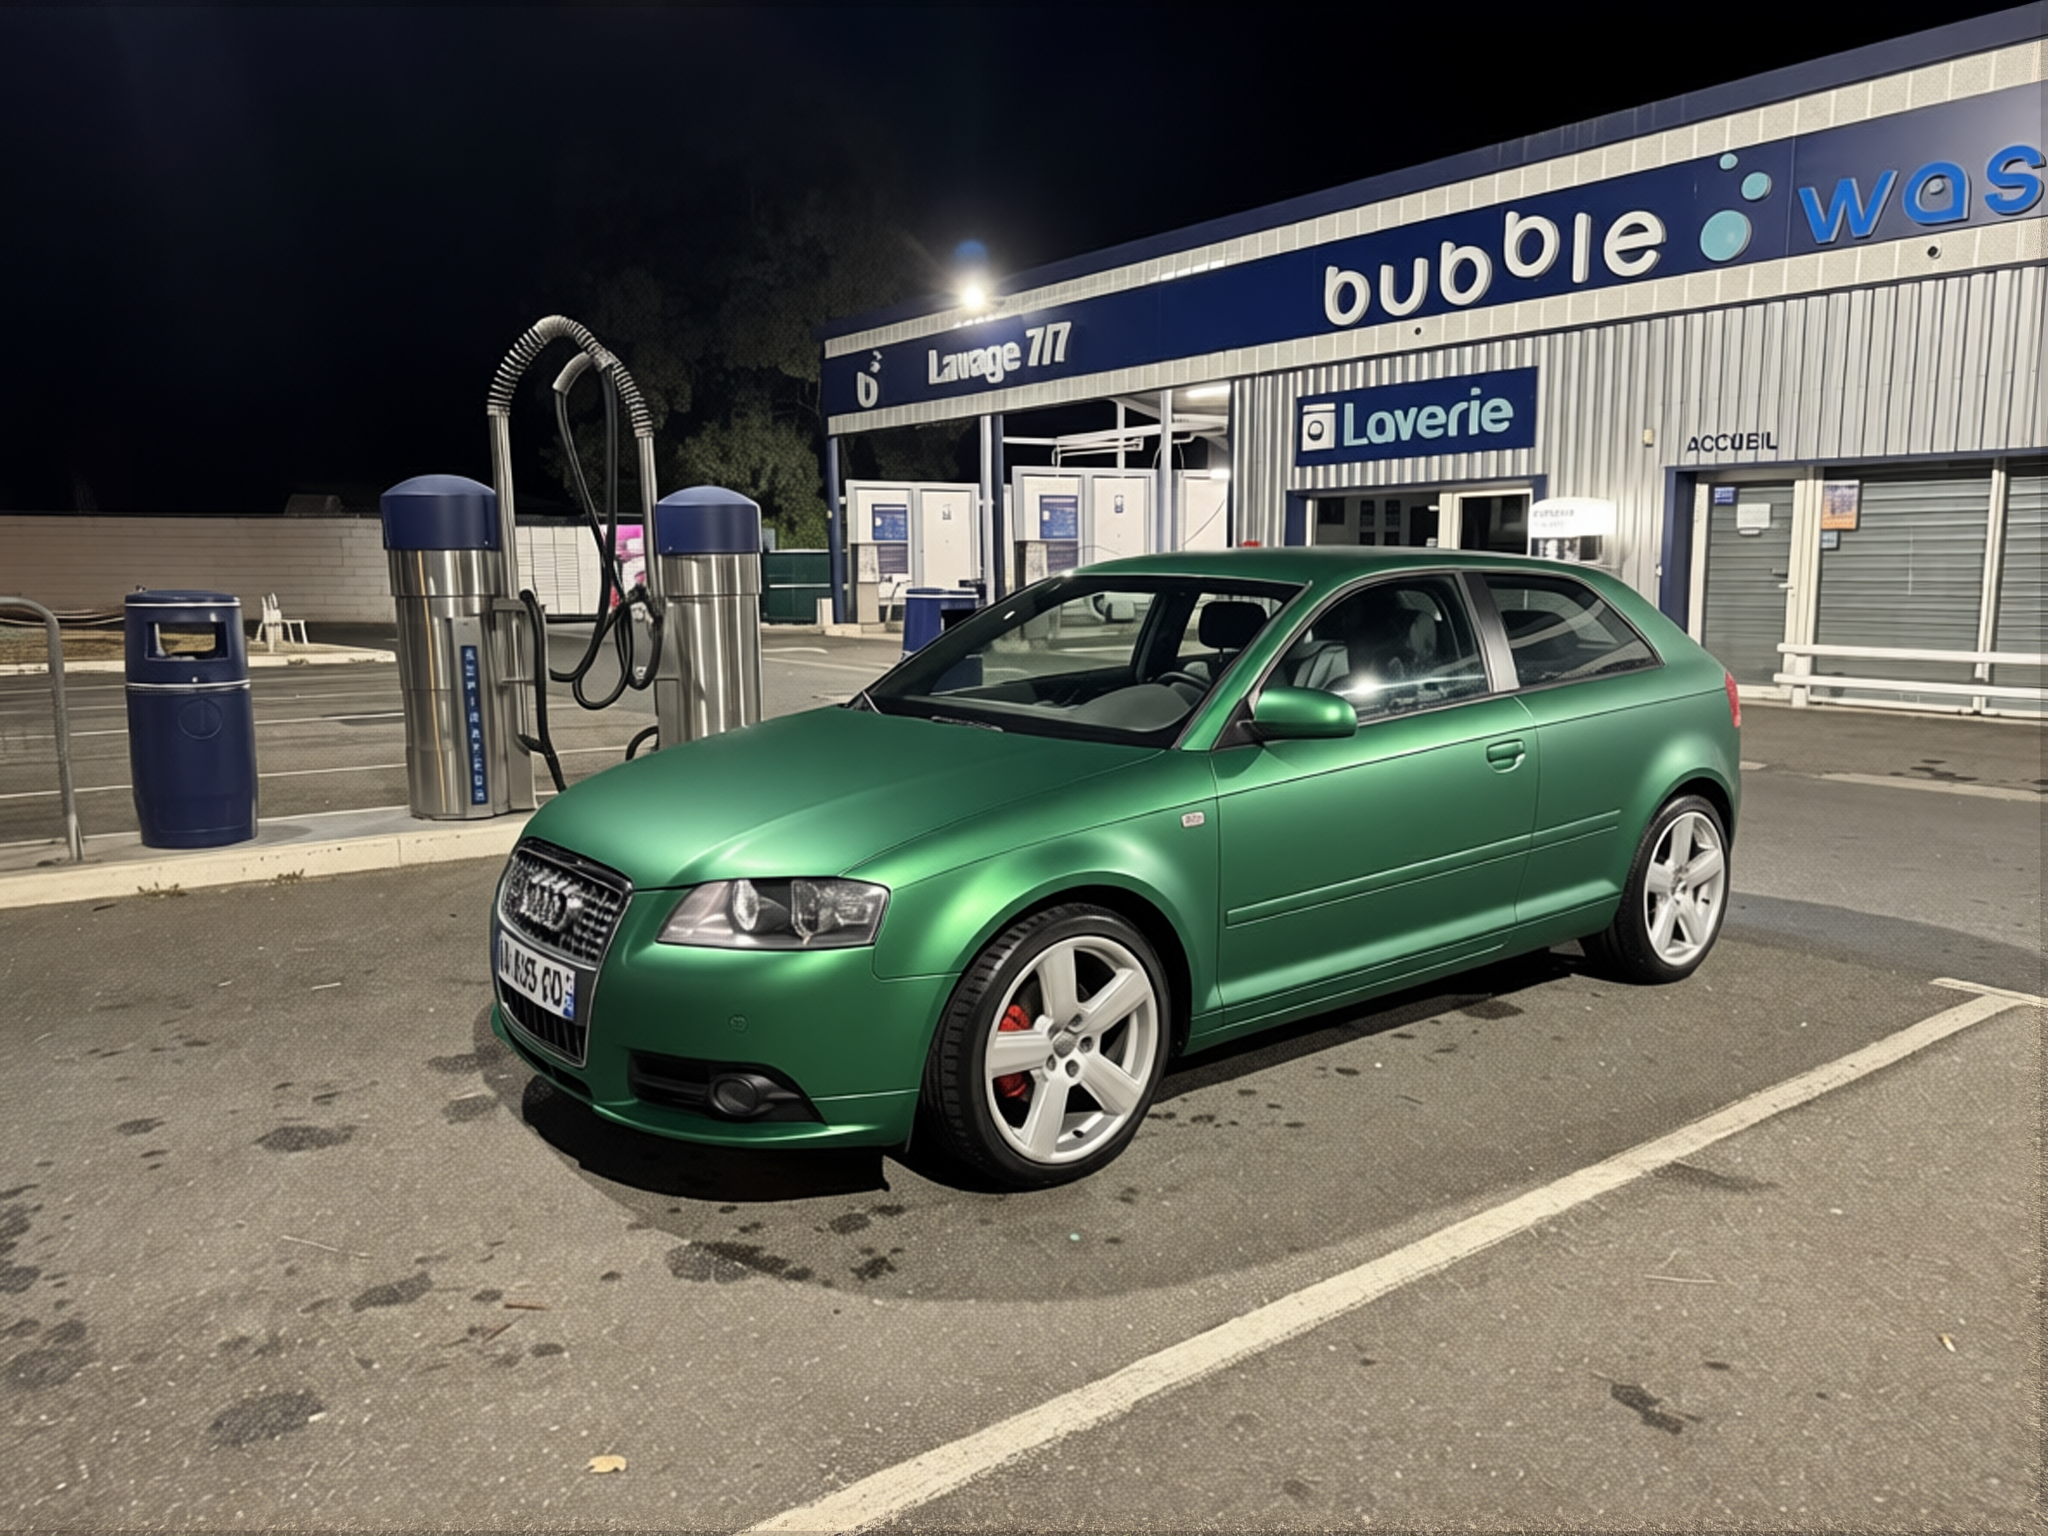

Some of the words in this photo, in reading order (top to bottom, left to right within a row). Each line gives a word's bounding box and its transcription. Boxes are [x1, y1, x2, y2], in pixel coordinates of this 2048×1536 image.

[1325, 210, 1667, 327] bubble
[928, 341, 1022, 385] Lavage
[1344, 387, 1515, 447] Laverie
